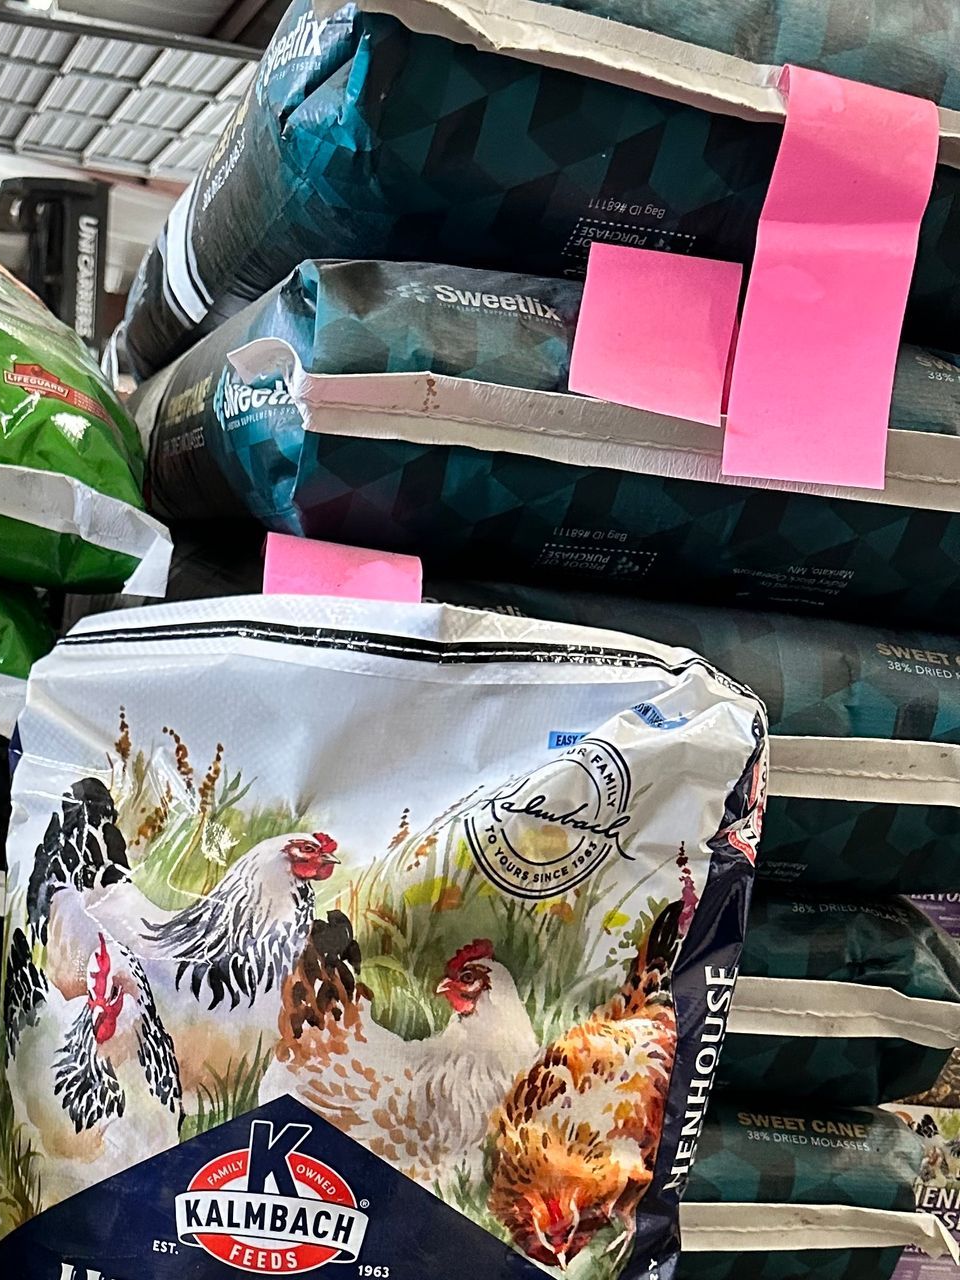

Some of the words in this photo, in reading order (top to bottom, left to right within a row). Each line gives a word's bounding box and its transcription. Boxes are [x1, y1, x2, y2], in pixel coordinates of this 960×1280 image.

[589, 198, 627, 213] #68111
[630, 204, 641, 216] ID
[644, 204, 666, 220] Bag
[582, 226, 647, 246] PURCHASE
[433, 284, 562, 322] Sweetlix
[7, 373, 66, 395] LIFEGUARD
[546, 551, 611, 564] PURCHASE
[875, 642, 951, 666] SWEET
[887, 660, 913, 673] 38%
[915, 665, 953, 680] DRIED
[555, 734, 579, 747] EASY
[589, 756, 617, 808] FAMILY
[481, 778, 636, 861] Kalmbach
[494, 848, 529, 882] YOURS
[532, 867, 570, 883] SINCE
[662, 965, 739, 1191] HENHOUSE
[736, 1111, 807, 1132] SWEET
[811, 1119, 869, 1139] CANE
[746, 1129, 770, 1142] 38%
[772, 1131, 809, 1146] DRIED
[810, 1136, 871, 1152] MOLASSES
[206, 1159, 244, 1187] FAMILY
[295, 1163, 337, 1197] OWNED
[184, 1199, 356, 1244] KALMBACH
[152, 1239, 179, 1255] EST.
[357, 1264, 391, 1278] 1963
[229, 1244, 298, 1269] FEEDS
